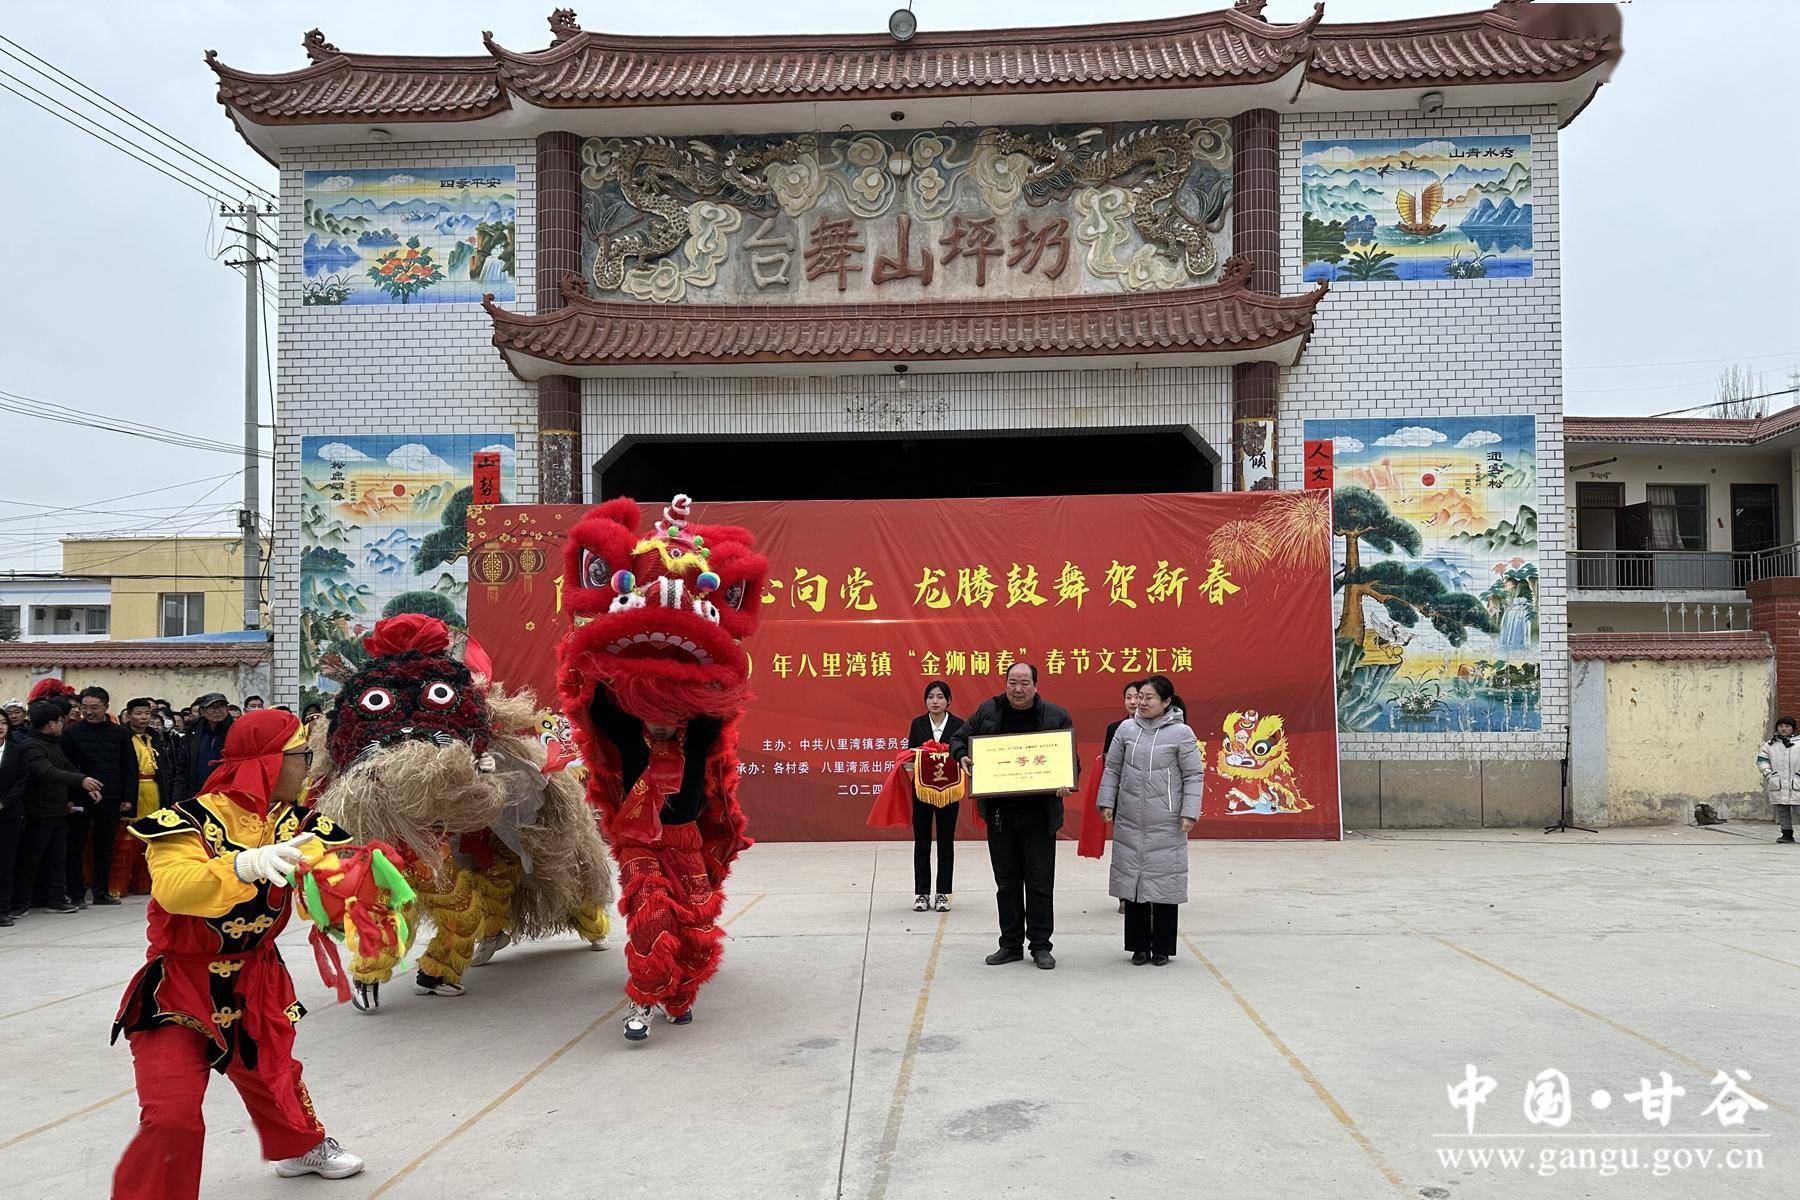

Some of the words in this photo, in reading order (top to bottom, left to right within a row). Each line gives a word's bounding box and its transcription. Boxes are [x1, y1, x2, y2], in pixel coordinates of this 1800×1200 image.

[1449, 146, 1515, 158] 山青水秀
[440, 177, 502, 188] 四季平安
[1308, 442, 1330, 489] 人文
[1486, 451, 1504, 489] 迎客松
[912, 559, 1241, 610] 龙腾鼓舞贺新春
[997, 754, 1048, 767] 一等奖
